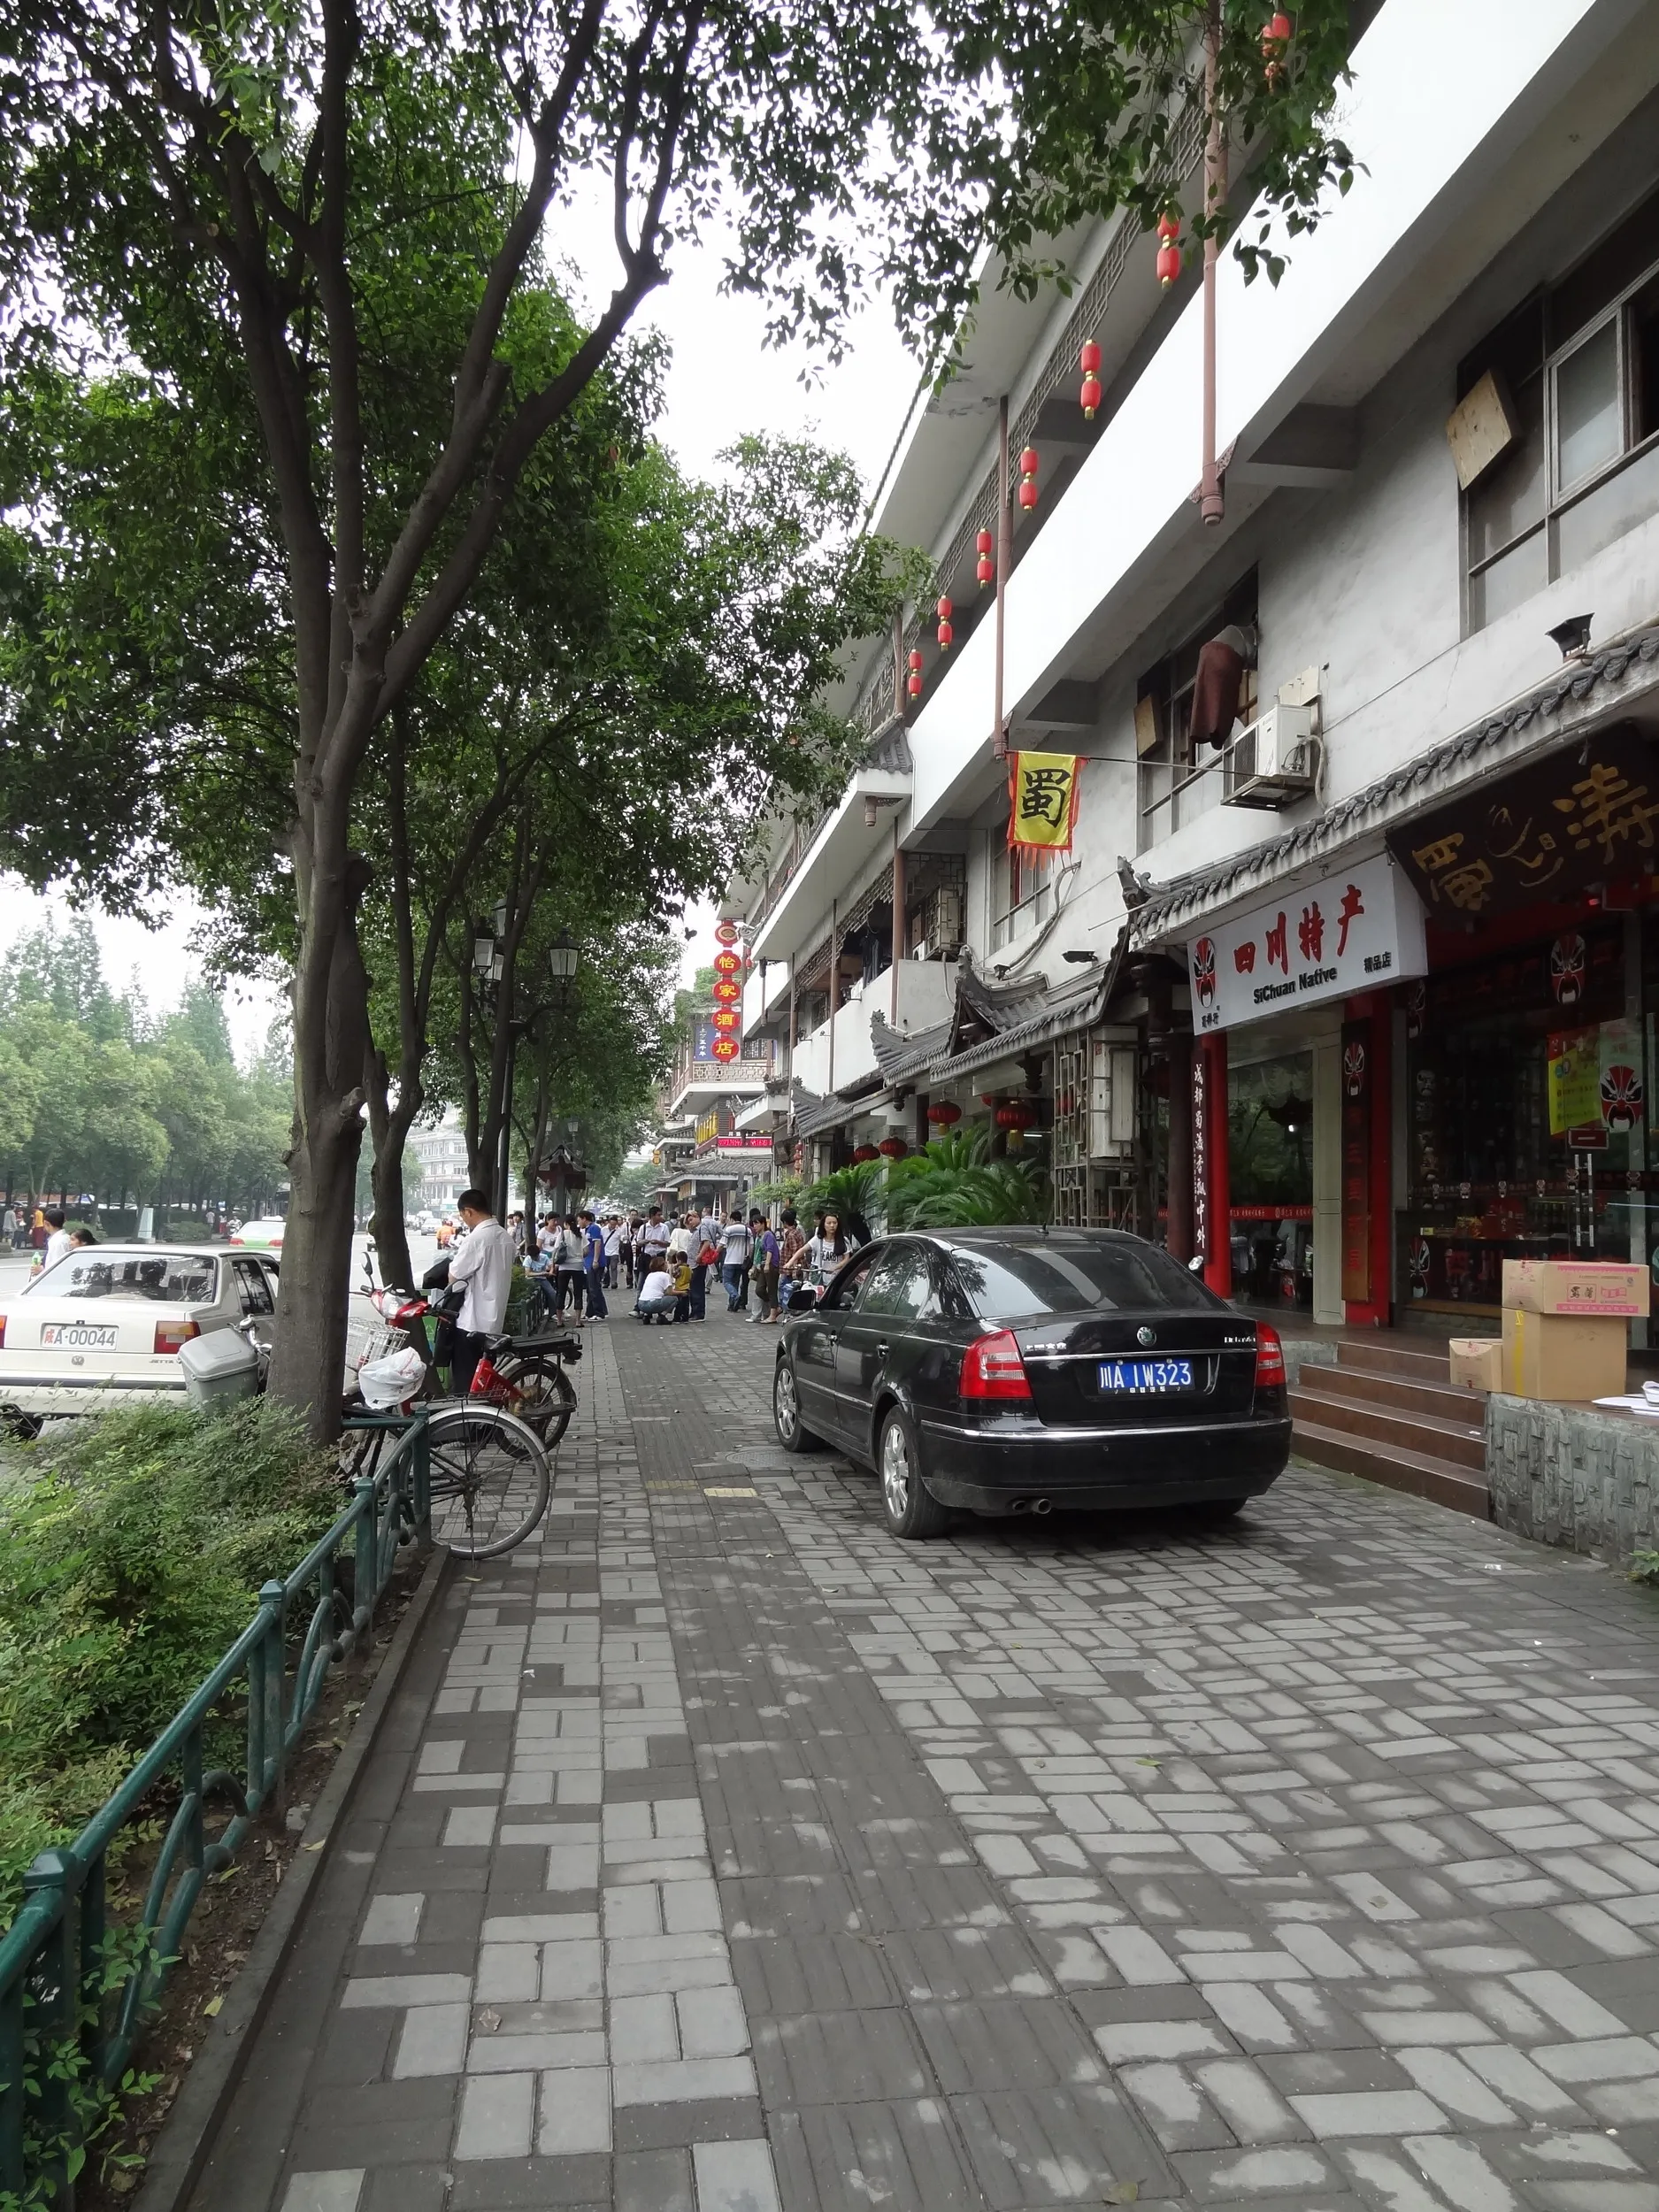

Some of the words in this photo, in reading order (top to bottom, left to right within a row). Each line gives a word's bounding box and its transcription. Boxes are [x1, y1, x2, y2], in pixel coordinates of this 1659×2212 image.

[1021, 769, 1071, 828] 蜀
[1233, 884, 1364, 975] 四川特产
[1254, 979, 1295, 1004] SiChuan
[1299, 966, 1337, 990] Native
[1363, 951, 1391, 974] 精品店
[716, 956, 736, 1055] 怡家酒店
